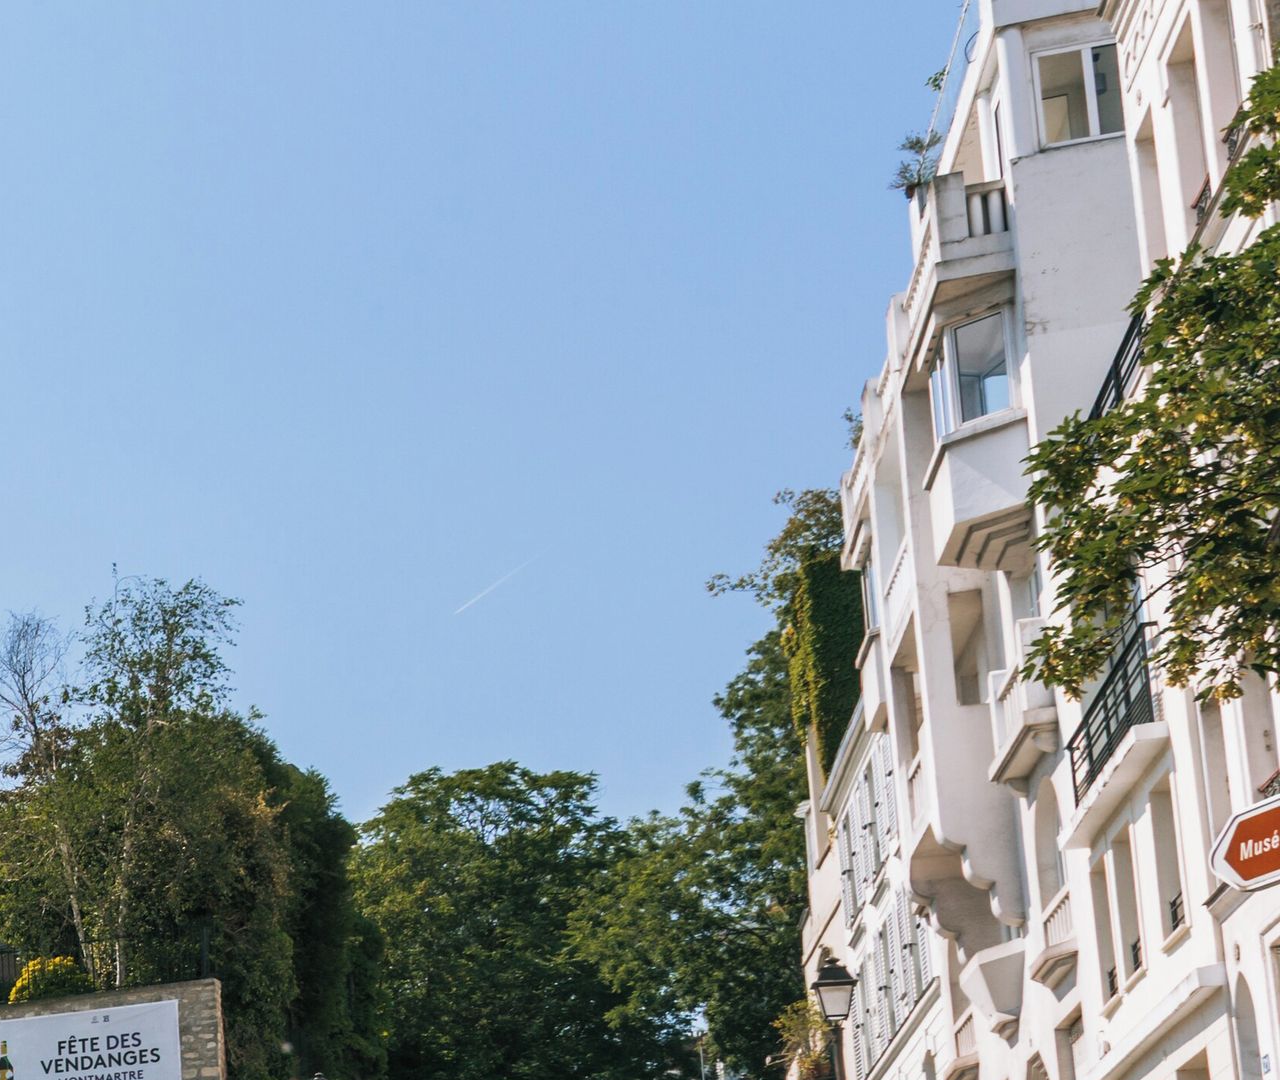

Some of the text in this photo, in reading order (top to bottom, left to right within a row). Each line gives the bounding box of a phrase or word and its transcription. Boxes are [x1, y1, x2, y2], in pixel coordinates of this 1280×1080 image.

[1240, 829, 1280, 861] Musé
[57, 1032, 142, 1056] FÊTE DES
[40, 1048, 161, 1075] VENDANGES
